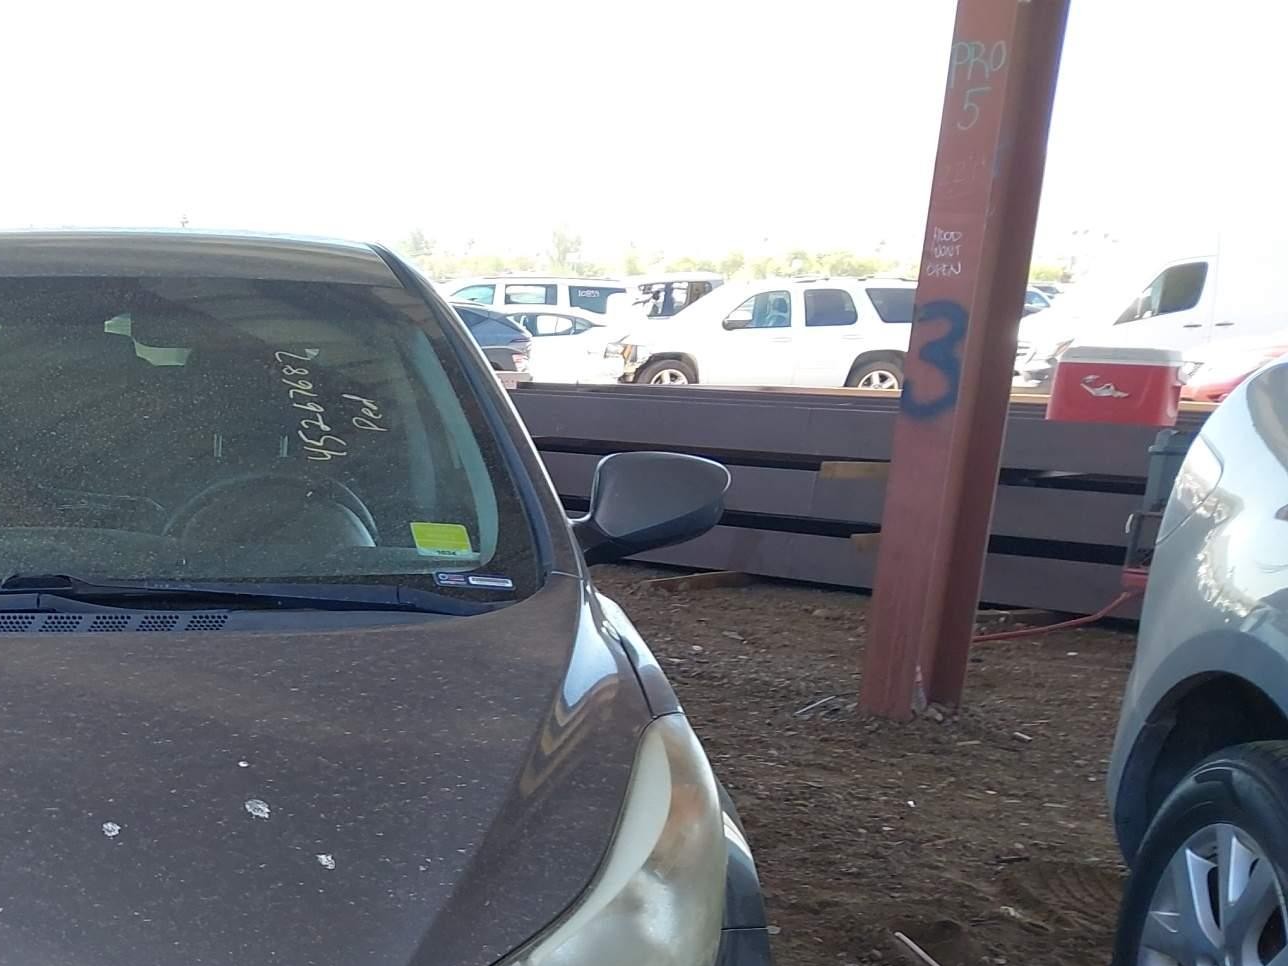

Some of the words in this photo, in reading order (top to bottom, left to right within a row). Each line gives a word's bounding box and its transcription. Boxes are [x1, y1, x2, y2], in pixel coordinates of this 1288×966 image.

[949, 40, 1007, 89] PRO
[956, 86, 991, 131] 5
[901, 299, 970, 420] 3
[275, 349, 347, 462] 45267687
